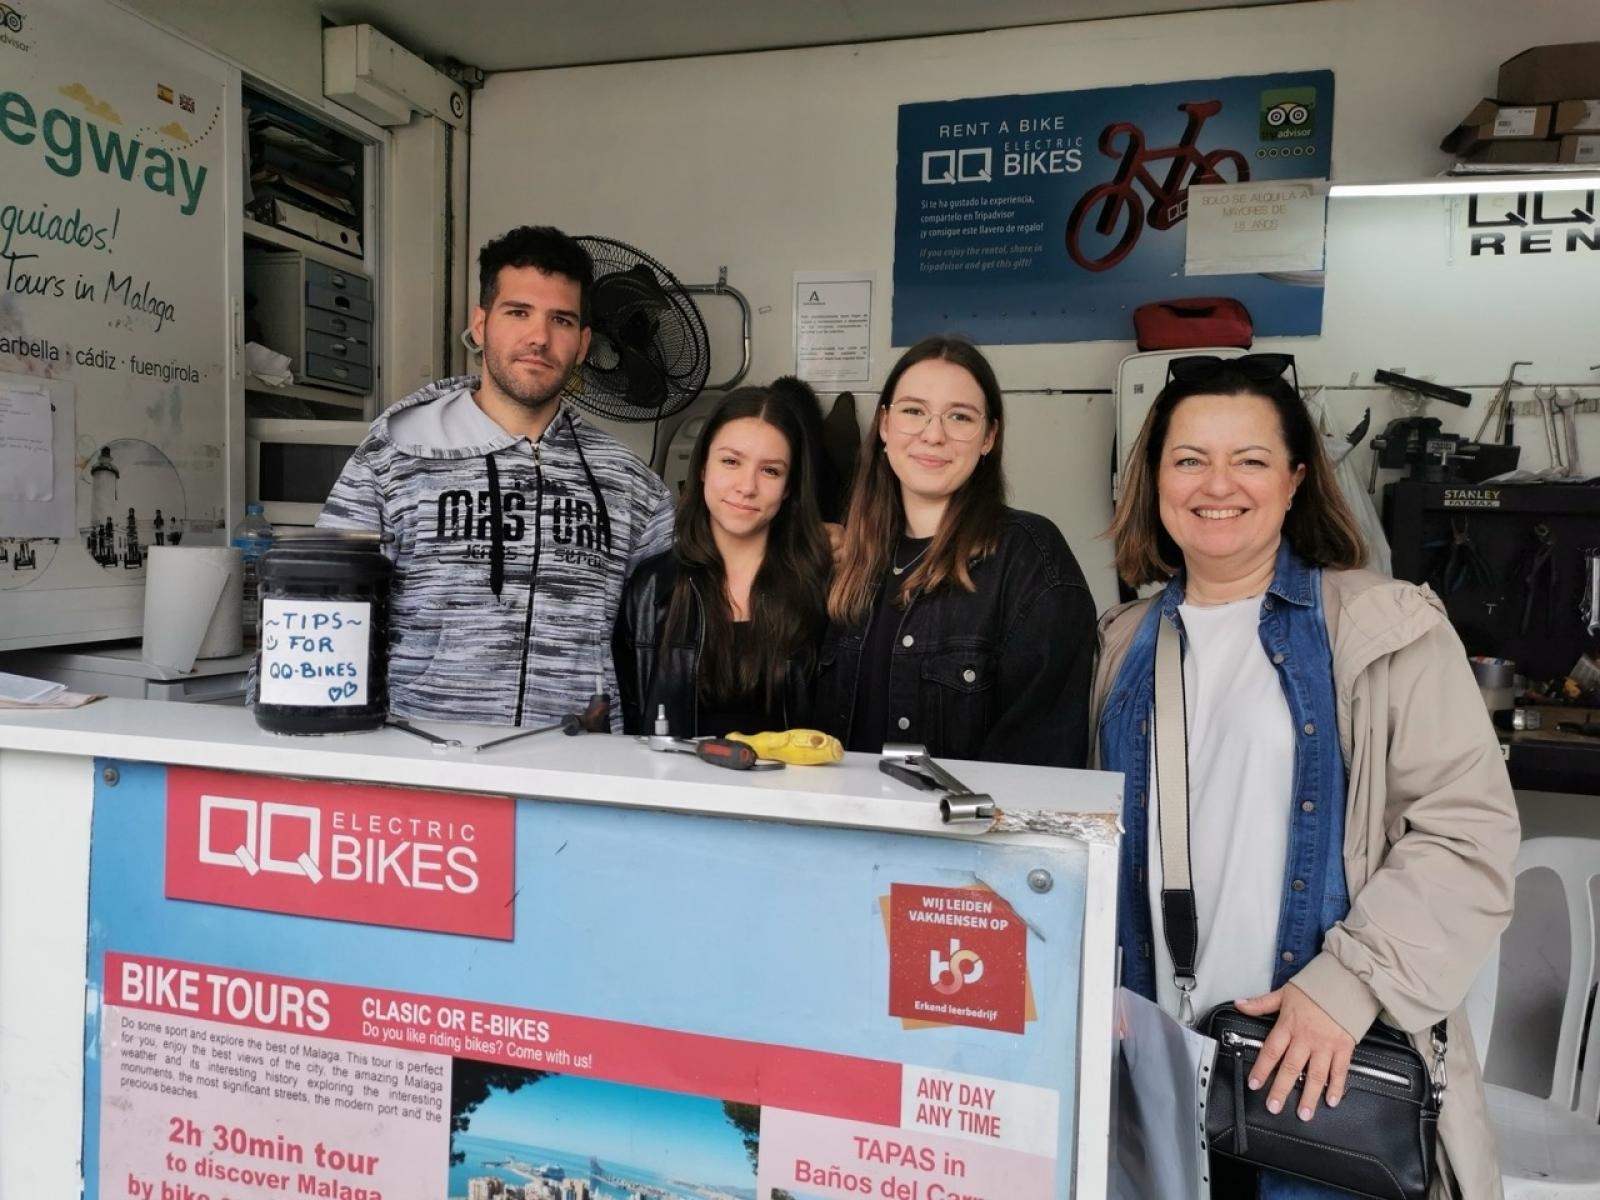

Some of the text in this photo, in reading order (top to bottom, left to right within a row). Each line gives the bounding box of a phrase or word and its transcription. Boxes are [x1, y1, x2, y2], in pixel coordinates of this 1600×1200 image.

[939, 116, 1065, 138] RENT A BIKE
[1004, 137, 1083, 151] ELECTRIC
[0, 91, 208, 216] egway
[921, 147, 1083, 184] QQ BIKES
[939, 199, 948, 208] ha
[949, 197, 980, 209] gustado
[981, 197, 988, 206] la
[1202, 189, 1309, 205] SOLO SE ALQUILA A
[1271, 204, 1288, 215] DE
[928, 227, 961, 238] consigue
[962, 227, 978, 236] este
[979, 225, 1004, 234] llavero
[1006, 223, 1015, 232] de
[963, 212, 973, 221] en
[0, 252, 175, 333] Tours in Malaga
[76, 348, 116, 371] cádiz
[130, 355, 200, 383] fuengirola
[1444, 489, 1501, 500] STANLEY
[288, 636, 334, 653] FOR
[199, 794, 479, 894] QQ BIKES
[332, 812, 475, 842] ELECTRIC
[908, 910, 1009, 931] VAKMENSEN OP
[922, 896, 992, 914] WIJ LEIDEN
[121, 961, 331, 1031] BIKE TOURS
[914, 1000, 998, 1022] Erkend leerbedrijf
[361, 997, 551, 1043] CLASIC OR E-BIKES
[121, 1016, 134, 1028] Do
[138, 1022, 161, 1033] some
[165, 1024, 187, 1038] sport
[190, 1029, 206, 1041] and
[209, 1034, 244, 1047] explore
[247, 1036, 262, 1050] the
[266, 1040, 287, 1054] best
[290, 1044, 300, 1056] of
[348, 1051, 368, 1065] This
[372, 1056, 391, 1068] tour
[396, 1059, 404, 1070] is
[407, 1062, 444, 1077] perfect
[121, 1032, 134, 1043] for
[163, 1040, 187, 1054] enjoy
[192, 1043, 206, 1055] the
[212, 1047, 231, 1060] best
[238, 1051, 264, 1065] views
[270, 1056, 280, 1067] of
[285, 1059, 301, 1071] the
[332, 1066, 349, 1078] the
[355, 1069, 399, 1087] amazing
[405, 1075, 443, 1093] Malaga
[362, 1022, 593, 1069] Do you like riding bikes? Come with us!
[121, 1047, 443, 1110] weather and its interesting history exploring the interesting
[121, 1077, 159, 1091] precious
[917, 1077, 995, 1110] ANY DAY
[179, 1070, 192, 1083] the
[196, 1074, 219, 1088] most
[223, 1078, 271, 1096] significant
[314, 1093, 331, 1105] the
[334, 1097, 373, 1112] modern
[378, 1103, 398, 1117] port
[402, 1107, 422, 1120] and
[426, 1111, 443, 1123] the
[916, 1103, 1001, 1138] ANY TIME
[168, 1116, 380, 1176] 2h 30min tour
[853, 1136, 966, 1177] TAPAS in
[128, 1174, 153, 1200] by
[165, 1152, 383, 1200] to discover Malaga
[794, 1159, 873, 1194] Baños
[880, 1175, 917, 1200] del
